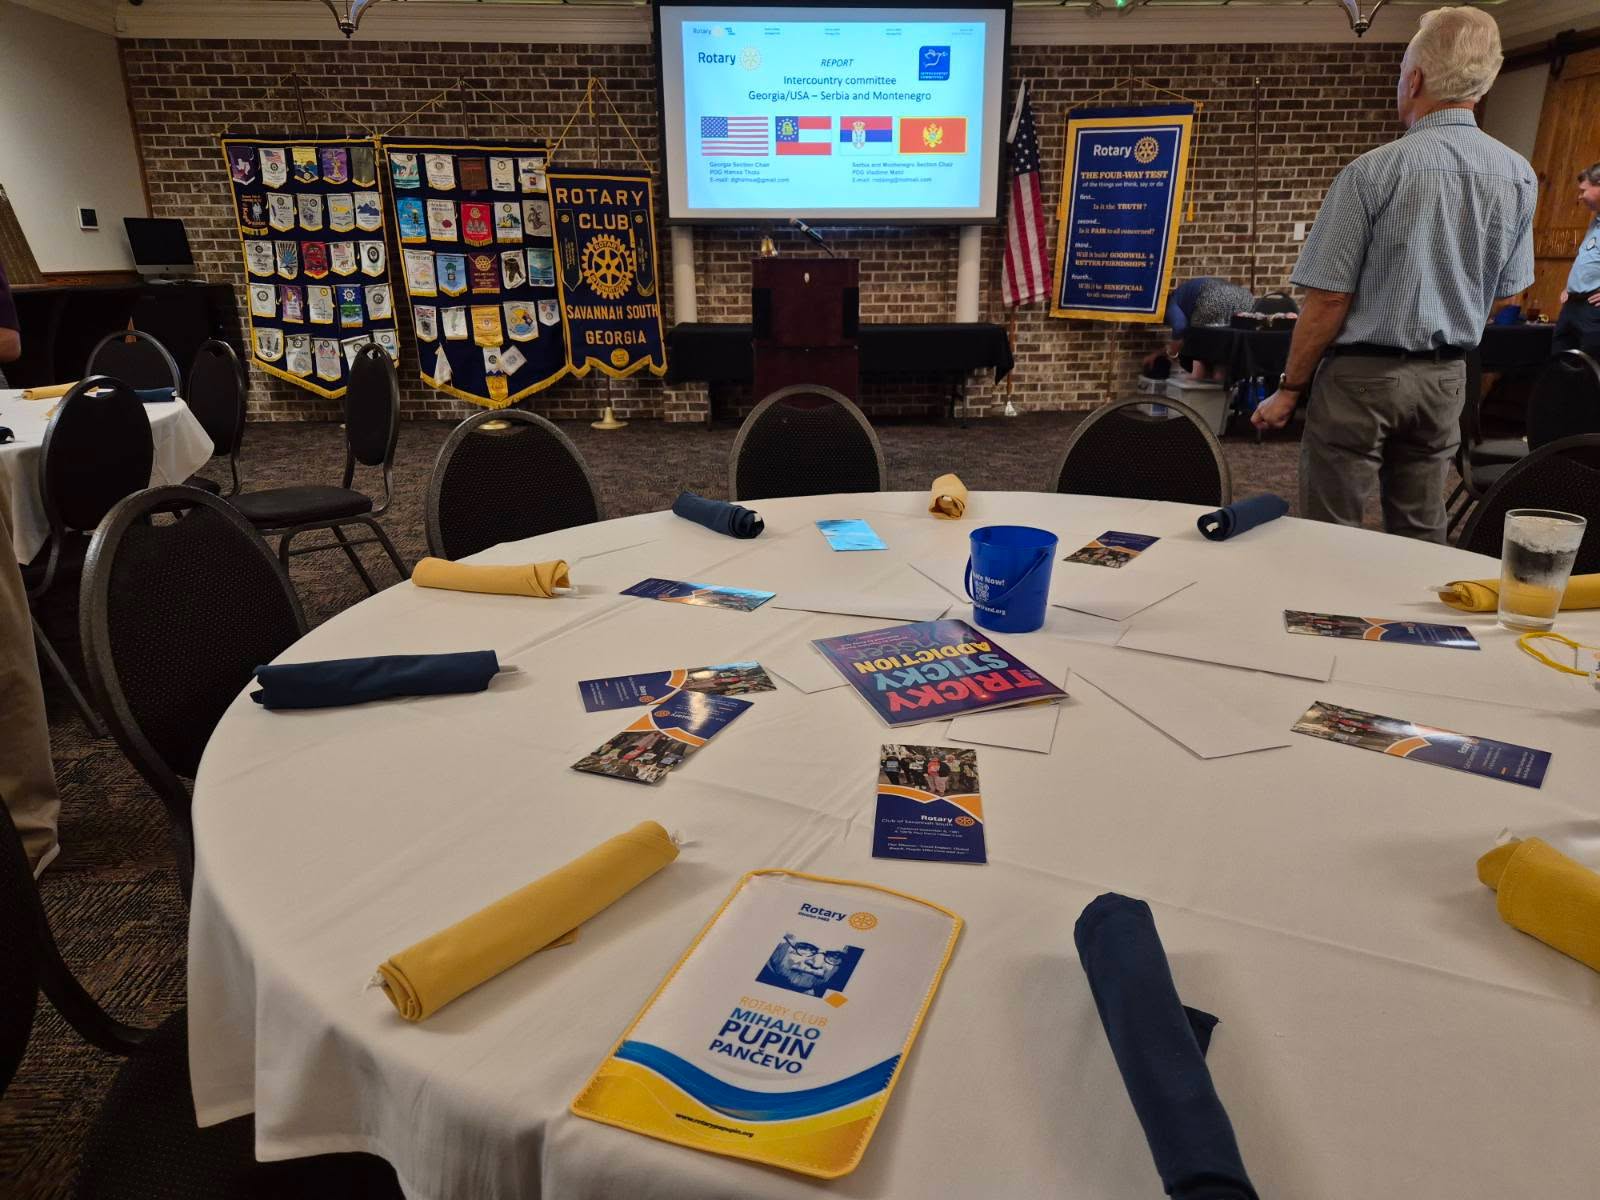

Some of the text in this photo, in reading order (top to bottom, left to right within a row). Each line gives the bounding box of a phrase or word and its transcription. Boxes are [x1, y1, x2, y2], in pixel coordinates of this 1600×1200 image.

[698, 52, 736, 66] Rotary
[821, 59, 854, 67] REPORT
[783, 75, 897, 87] Intercountry committee
[748, 91, 809, 102] Georgia/USA
[820, 90, 850, 100] Serbia
[852, 91, 871, 101] and
[873, 91, 932, 102] Montenegro
[1093, 144, 1132, 158] Rotary
[1081, 170, 1168, 179] THE FOUR-WAY TEST
[555, 188, 643, 206] ROTARY
[578, 213, 630, 230] CLUB
[1110, 251, 1147, 259] GOODWILL
[567, 303, 659, 320] SAVANNAH SOUTH
[585, 330, 647, 345] GEORGIA
[853, 641, 992, 673] ADDICTION
[874, 653, 1009, 691] STICKY
[886, 669, 1043, 712] TRICKY
[921, 815, 953, 823] Rotary
[800, 903, 847, 921] Rotary
[739, 996, 828, 1028] ROTARY CLUB
[730, 1007, 821, 1040] MIHAJLO
[718, 1019, 816, 1060] PUPIN
[709, 1039, 802, 1074] PANČEVO
